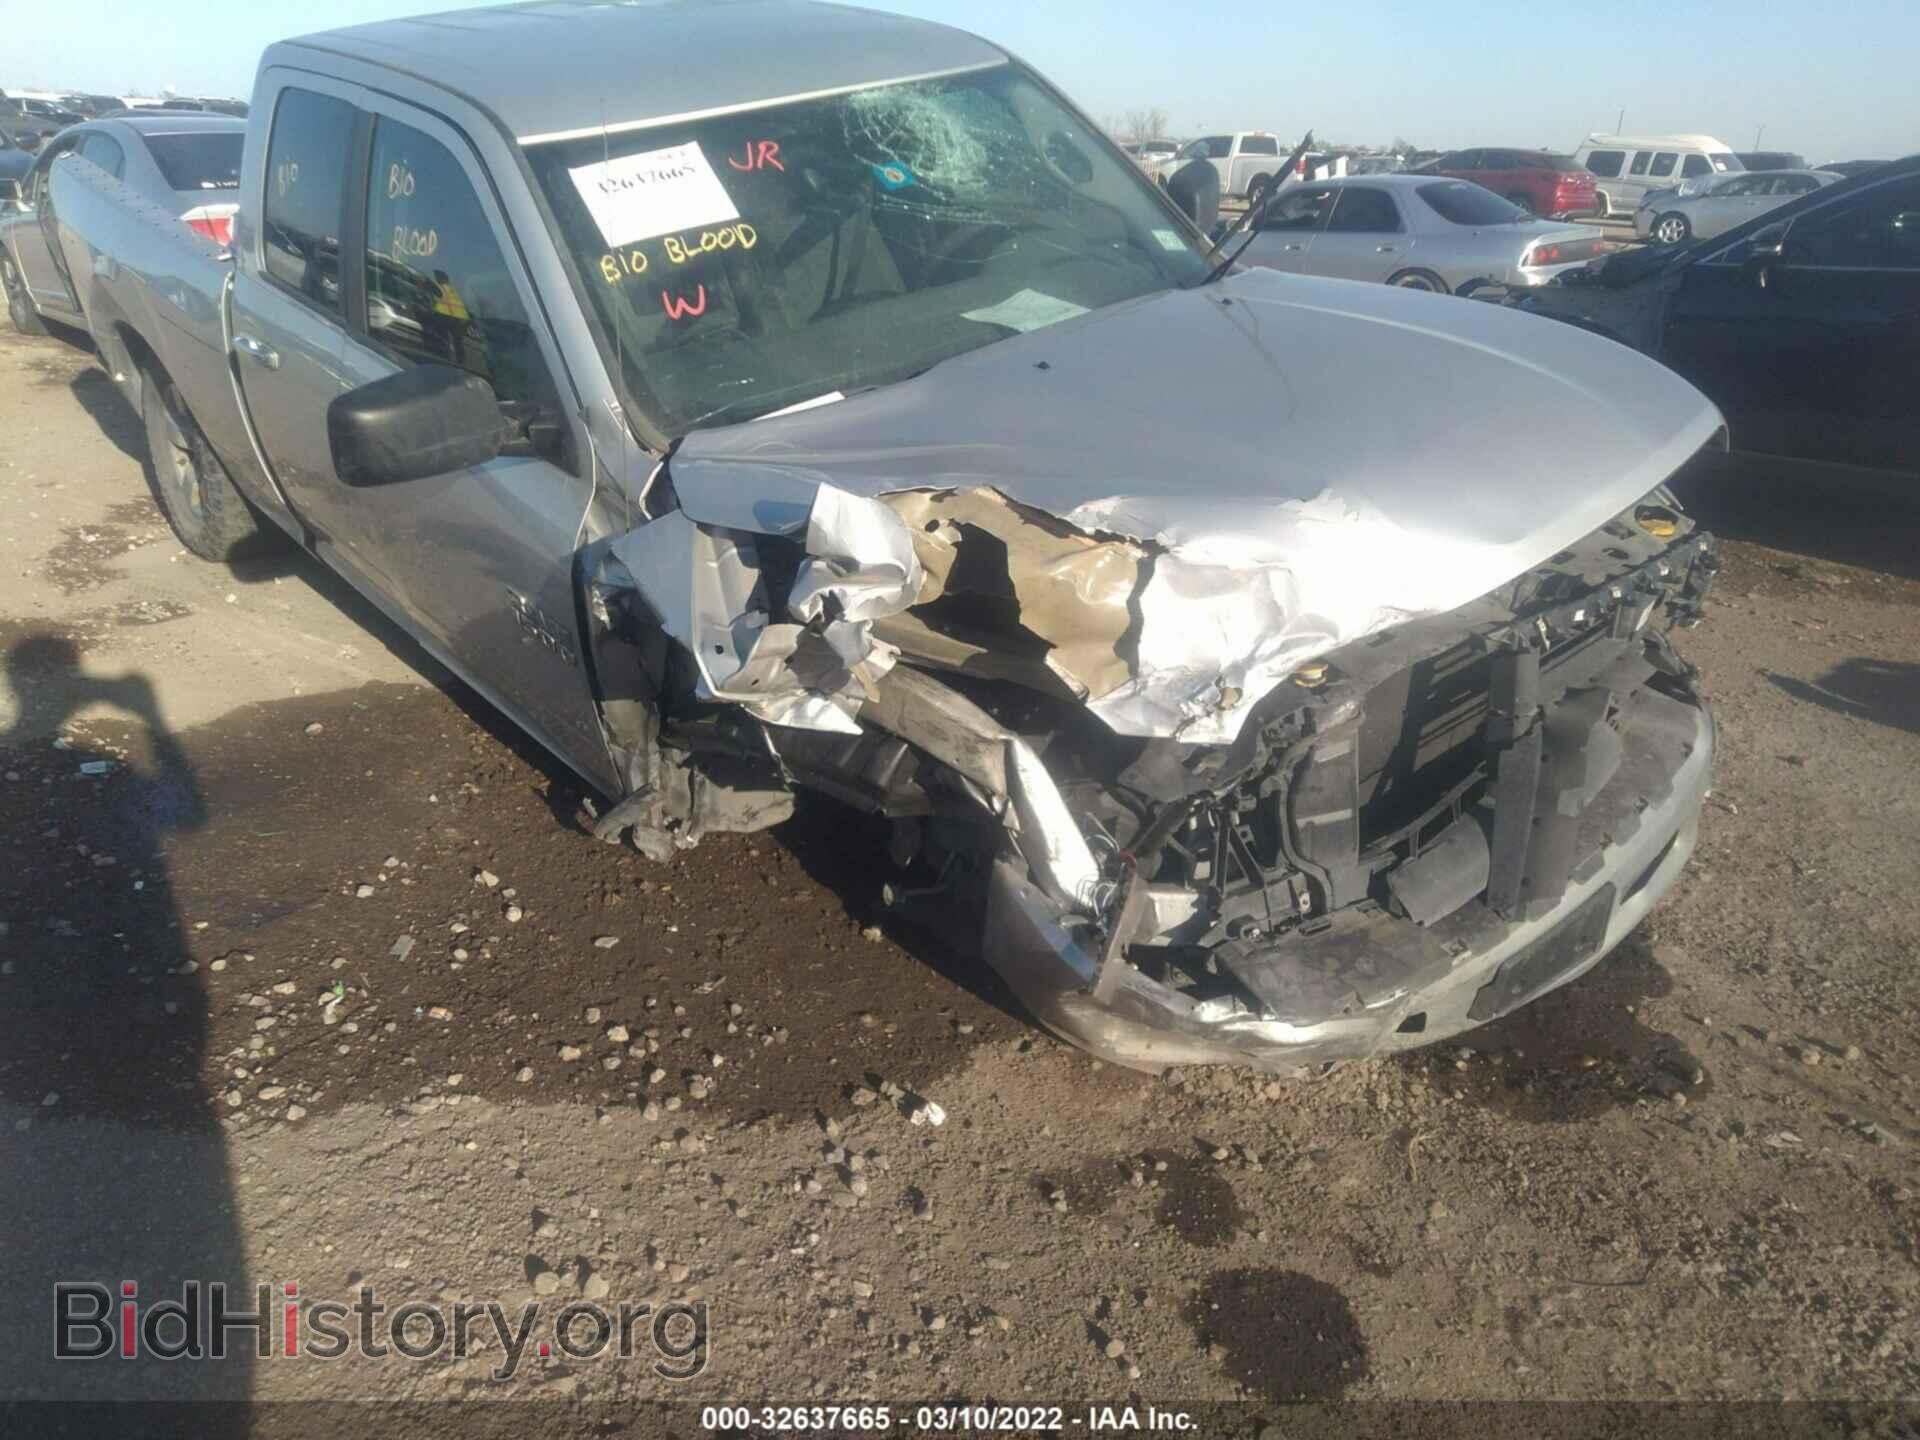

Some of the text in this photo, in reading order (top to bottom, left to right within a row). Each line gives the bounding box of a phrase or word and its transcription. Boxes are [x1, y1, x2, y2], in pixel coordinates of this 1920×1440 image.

[728, 140, 785, 173] JR
[663, 222, 757, 265] BLOOD
[661, 283, 708, 321] W
